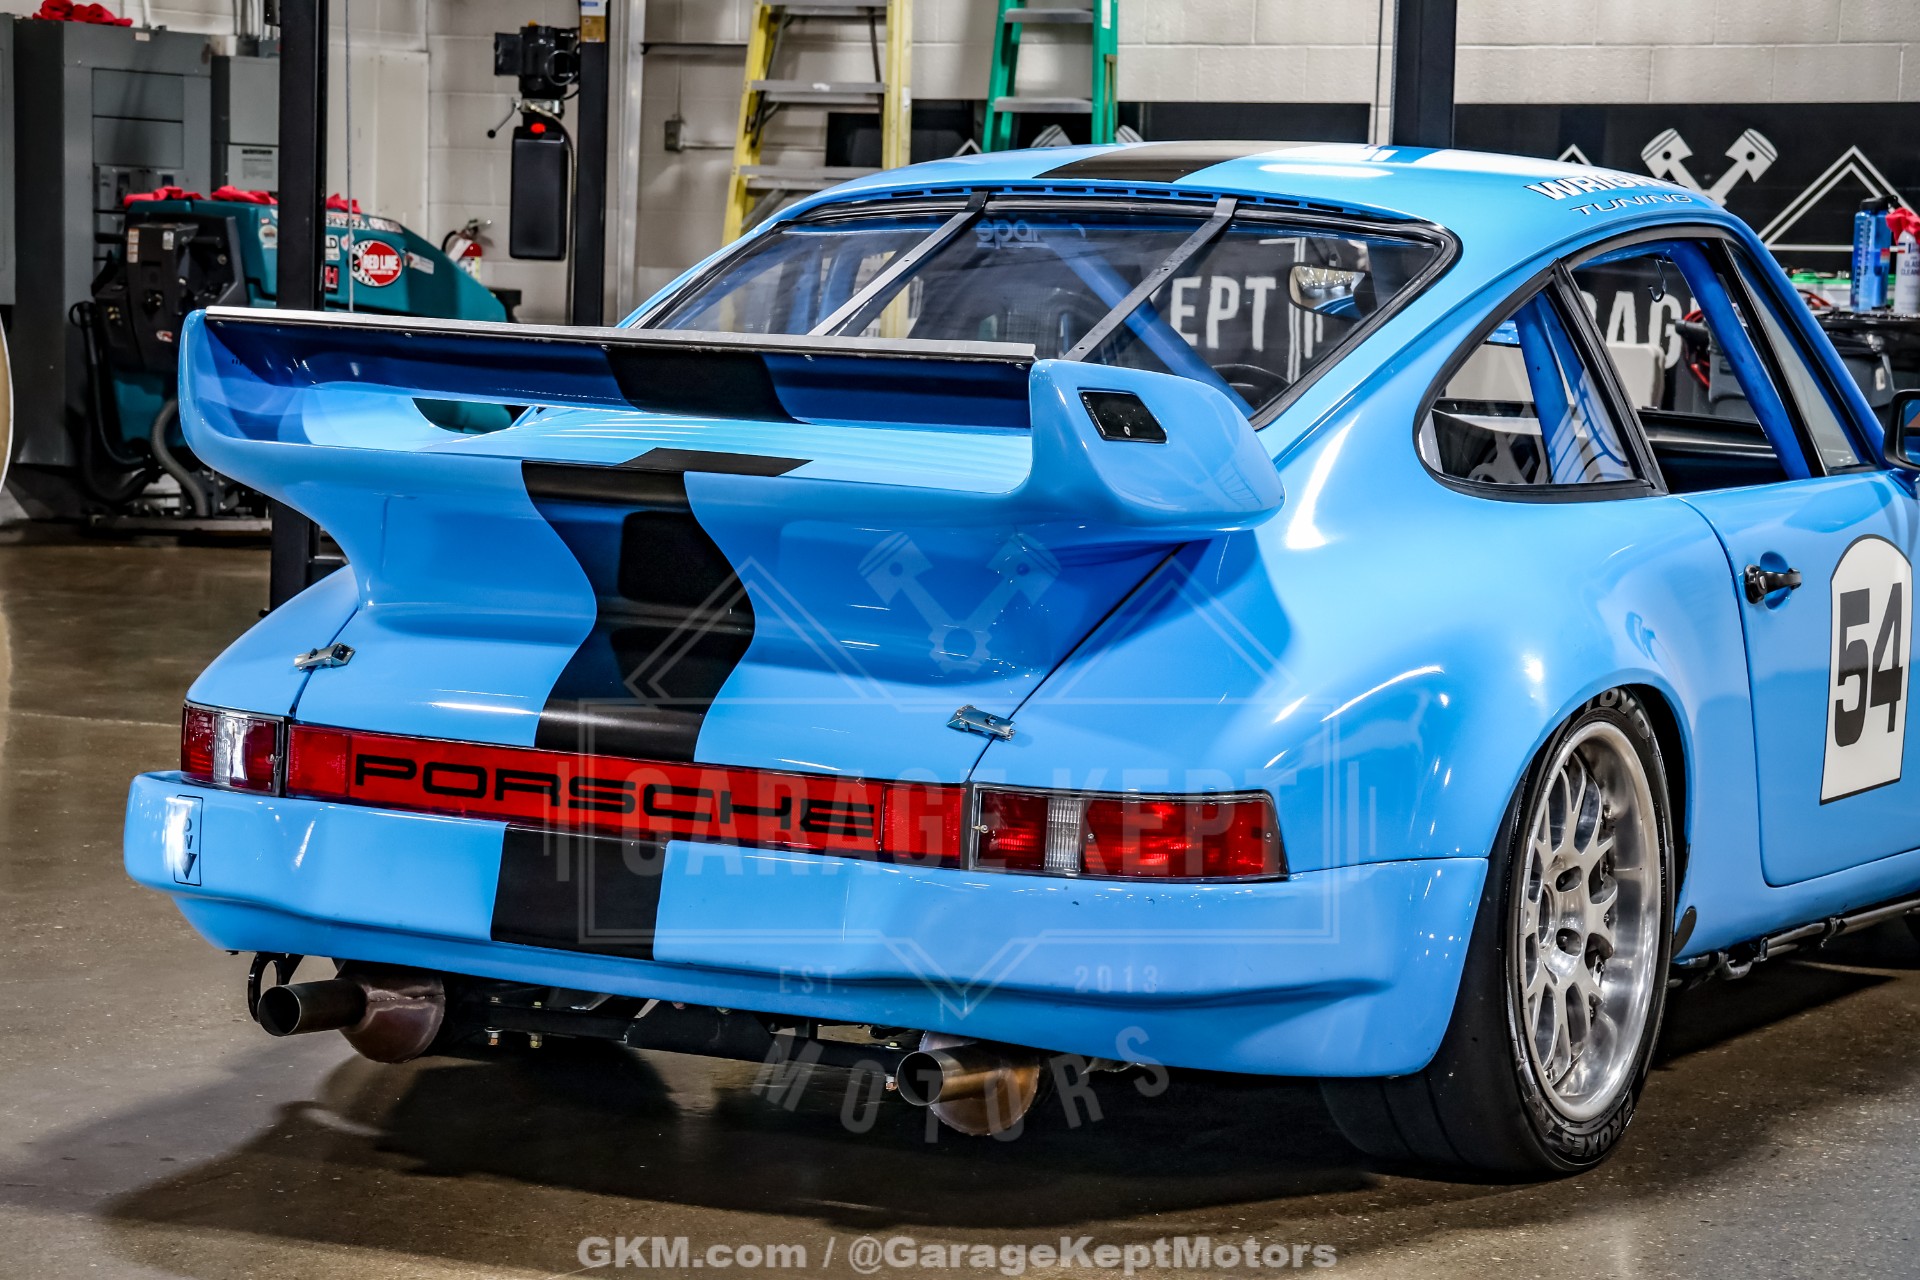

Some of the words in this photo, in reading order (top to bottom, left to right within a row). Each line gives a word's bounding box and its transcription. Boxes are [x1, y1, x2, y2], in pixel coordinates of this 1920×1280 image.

[1569, 193, 1693, 216] TUNING
[1150, 275, 1277, 352] EPT
[1834, 582, 1903, 747] 54
[355, 753, 876, 839] PORSCHE
